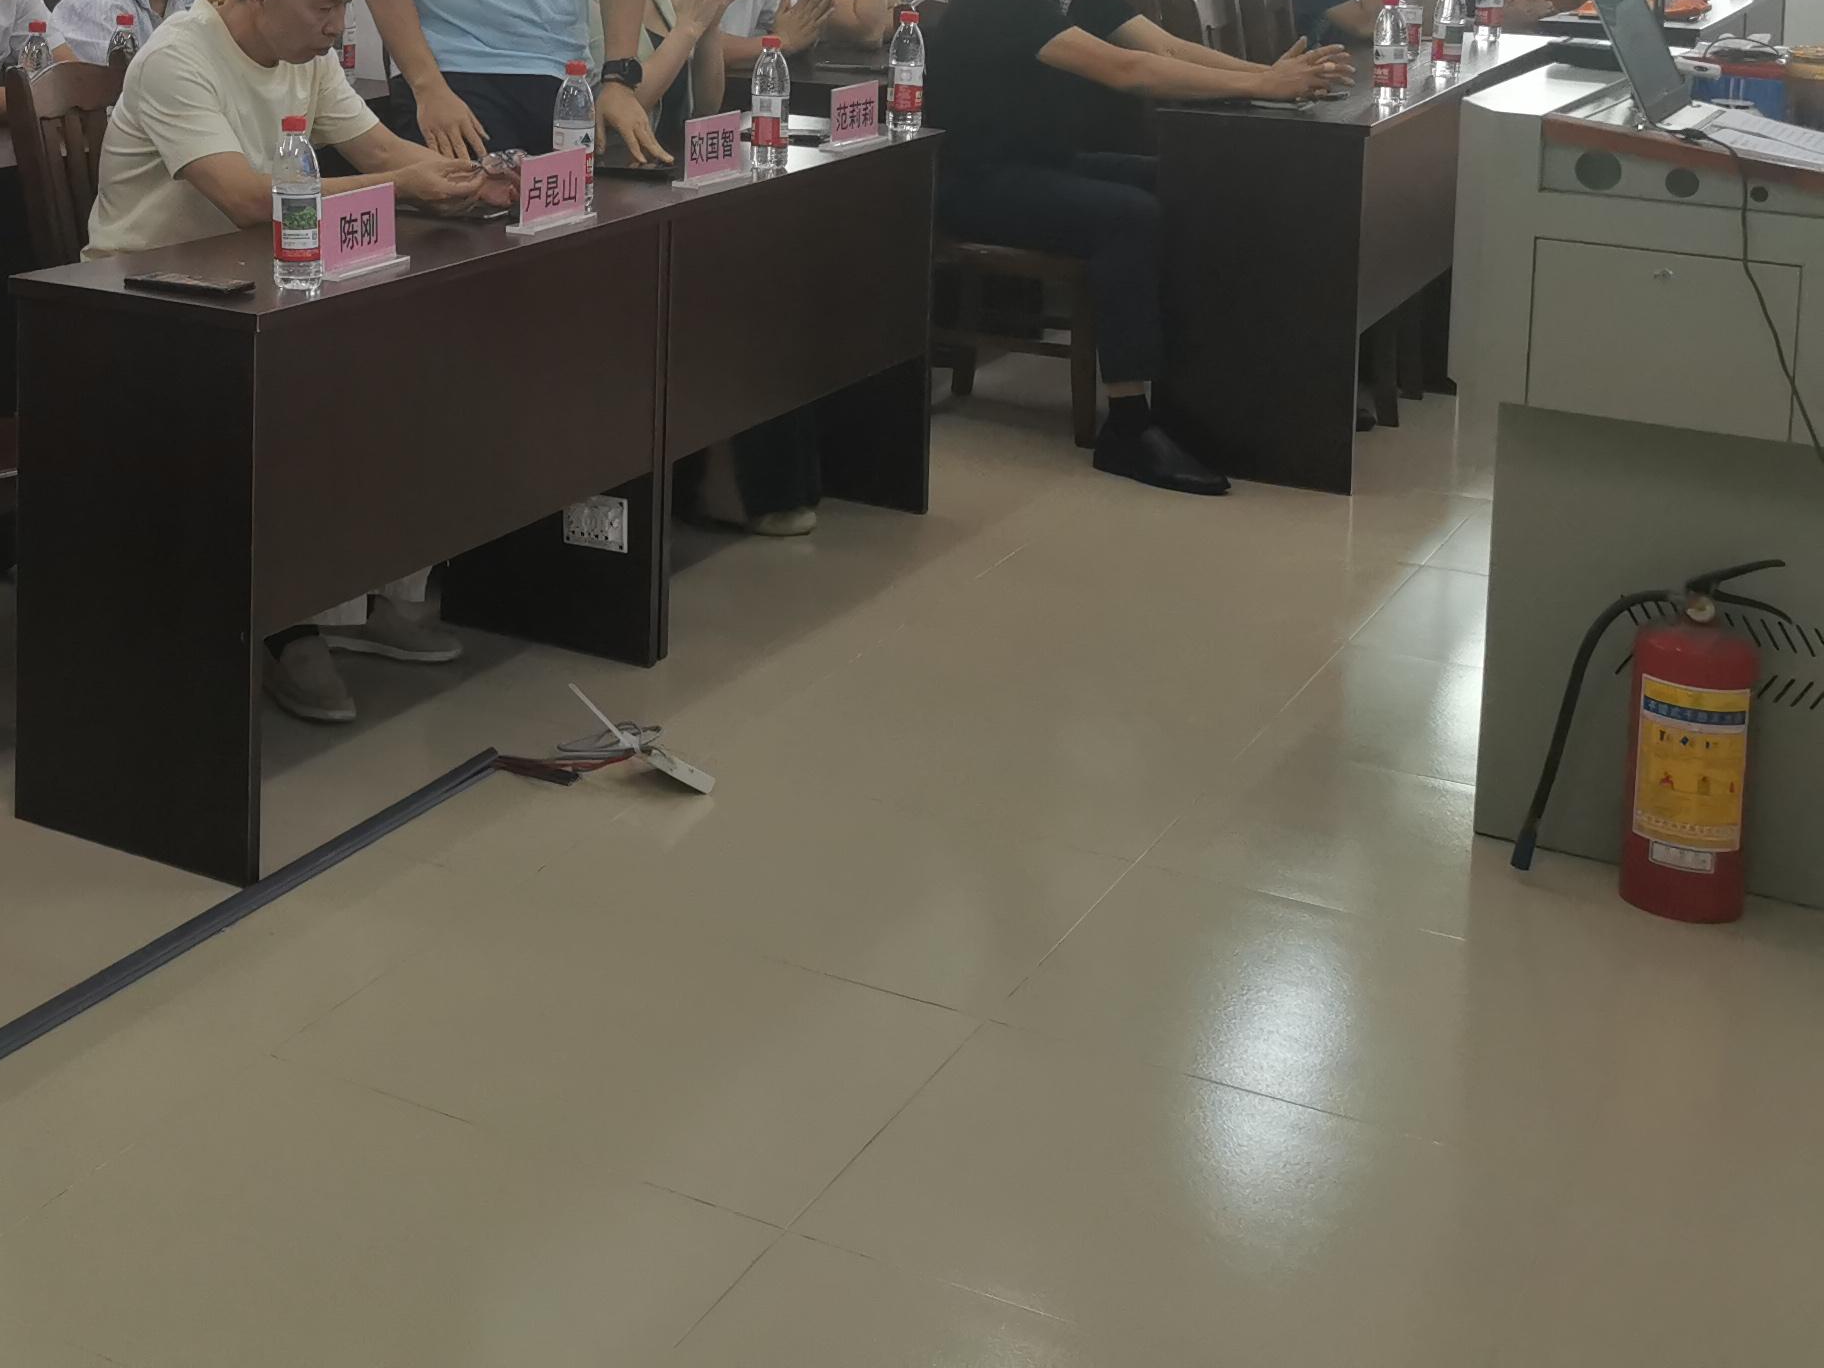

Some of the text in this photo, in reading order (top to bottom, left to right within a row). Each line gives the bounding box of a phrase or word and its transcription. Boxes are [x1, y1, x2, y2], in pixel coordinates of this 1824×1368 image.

[835, 99, 875, 131] 范莉莉
[689, 129, 735, 165] 欧国智
[526, 170, 578, 213] 卢昆山
[340, 207, 379, 253] 陈刚
